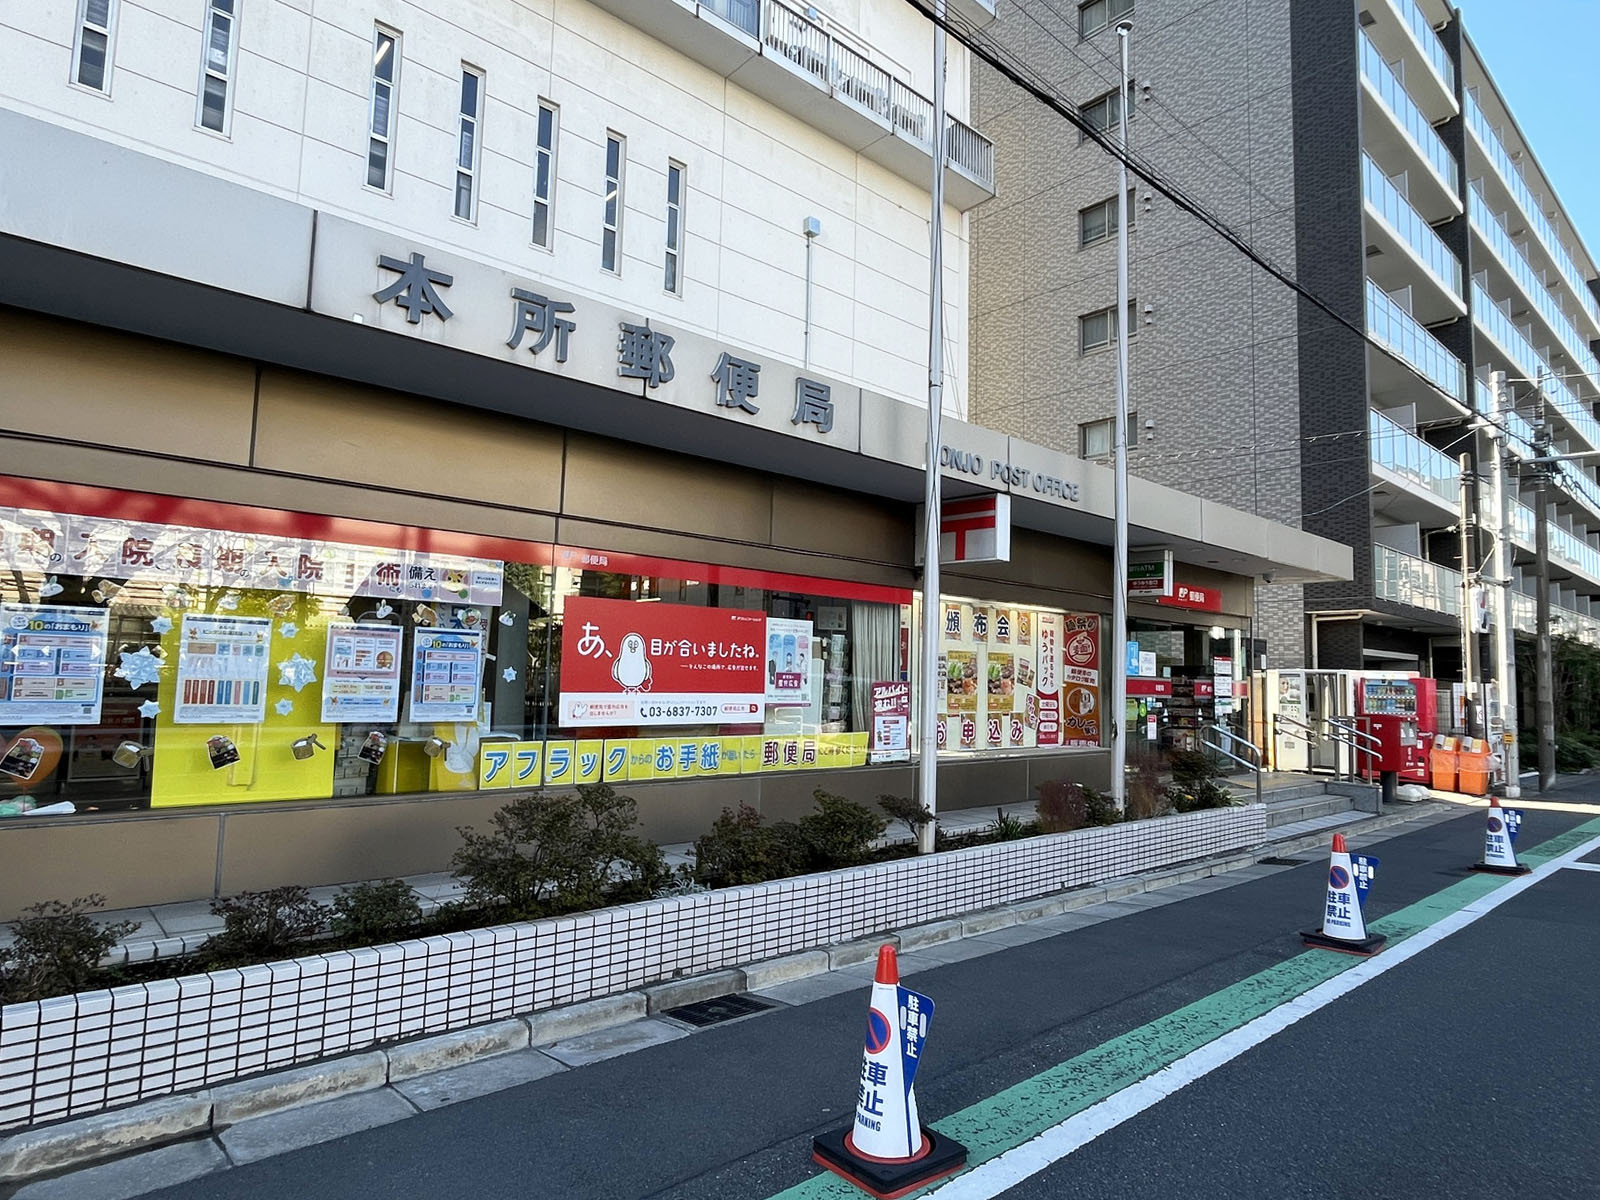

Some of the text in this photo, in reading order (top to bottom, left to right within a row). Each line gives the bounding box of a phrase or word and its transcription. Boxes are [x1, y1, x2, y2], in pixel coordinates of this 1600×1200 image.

[372, 251, 835, 434] 本所郵便局
[990, 459, 1030, 488] POST
[1032, 472, 1080, 502] OFFICE
[409, 566, 436, 581] 備え
[945, 610, 1009, 636] 頒布会
[577, 621, 760, 659] あ、 目が合いましたね。
[873, 684, 909, 699] アルバイト
[649, 706, 718, 718] 03-6837-7307
[1065, 716, 1096, 729] カレー
[906, 994, 920, 1059] 駐車禁止
